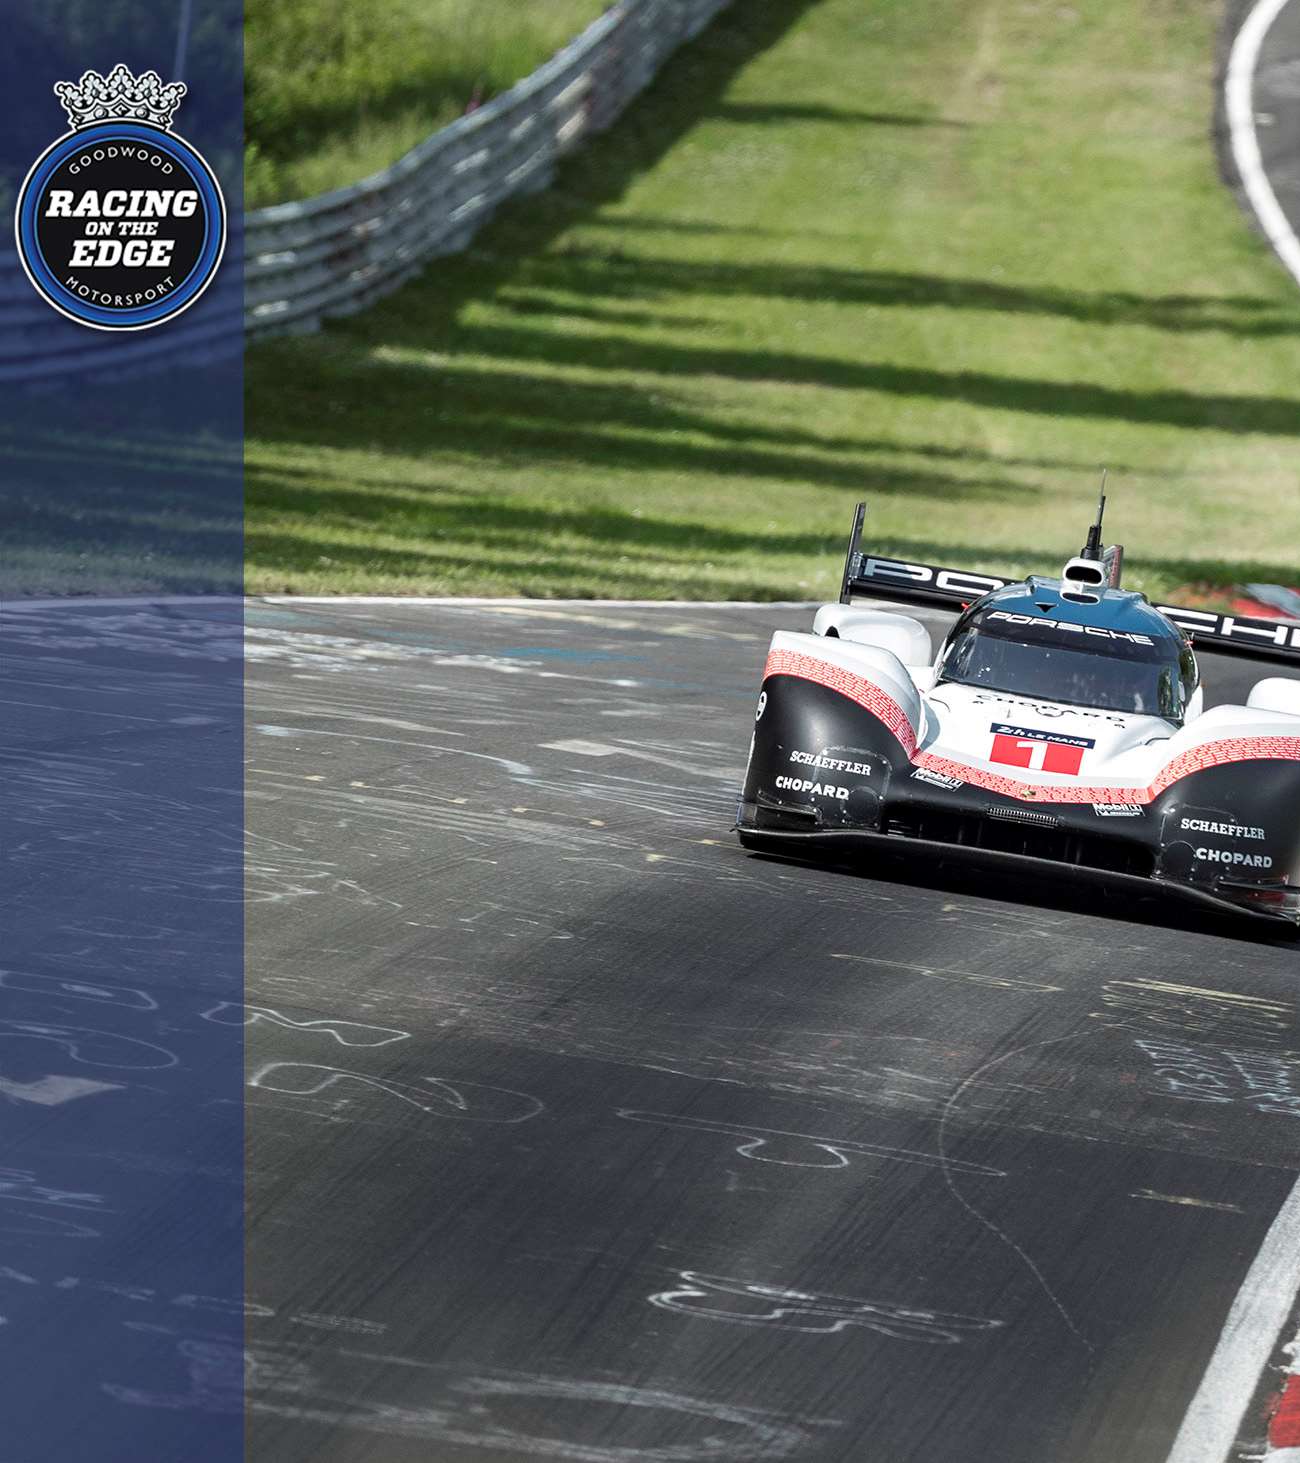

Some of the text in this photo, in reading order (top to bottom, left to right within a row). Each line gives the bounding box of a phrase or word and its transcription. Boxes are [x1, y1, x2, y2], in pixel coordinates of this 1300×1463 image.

[986, 611, 1155, 646] PORSCHE
[789, 750, 872, 776] SCHAEFFLER
[1016, 740, 1049, 771] 1
[775, 775, 849, 800] CHOPARD
[1181, 818, 1265, 840] SCHAEFFLER
[1196, 847, 1273, 868] CHOPARD
